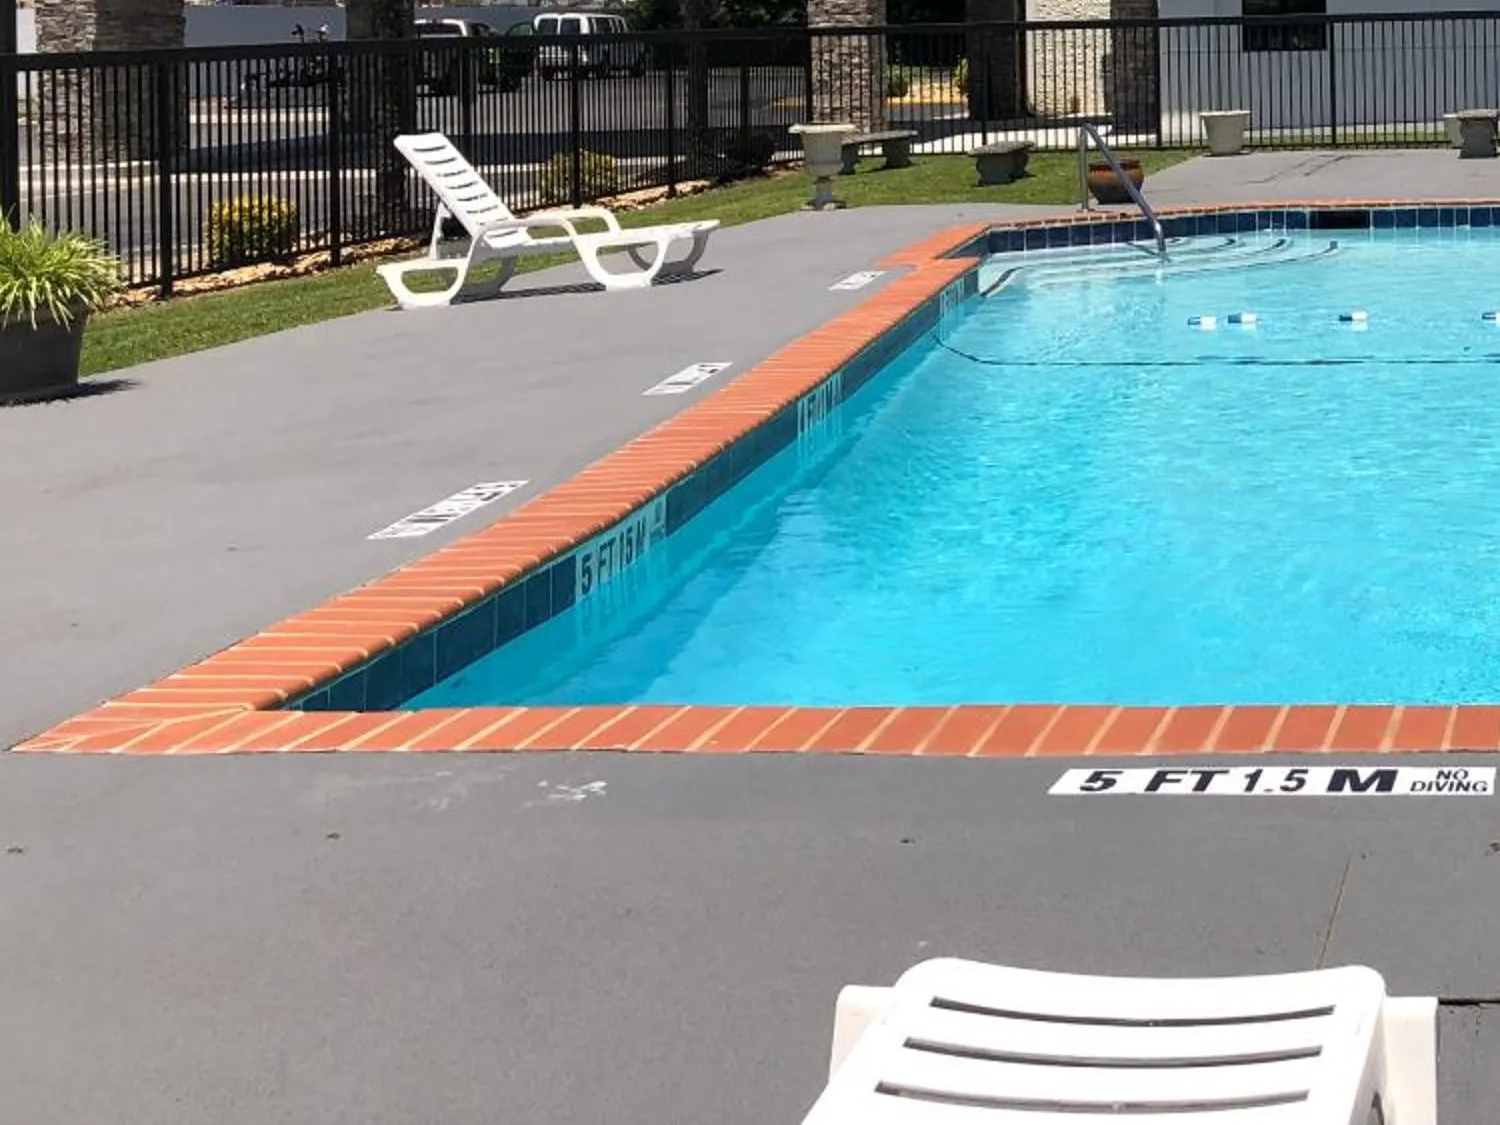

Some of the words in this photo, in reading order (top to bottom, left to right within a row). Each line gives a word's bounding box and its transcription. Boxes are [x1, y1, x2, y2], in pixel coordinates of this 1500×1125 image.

[580, 552, 593, 596] 5
[598, 536, 617, 585] FT
[1079, 770, 1124, 792] 5
[1144, 769, 1230, 792] FT
[1326, 768, 1399, 793] M
[1435, 768, 1469, 780] NO
[1410, 780, 1488, 792] DIVING
